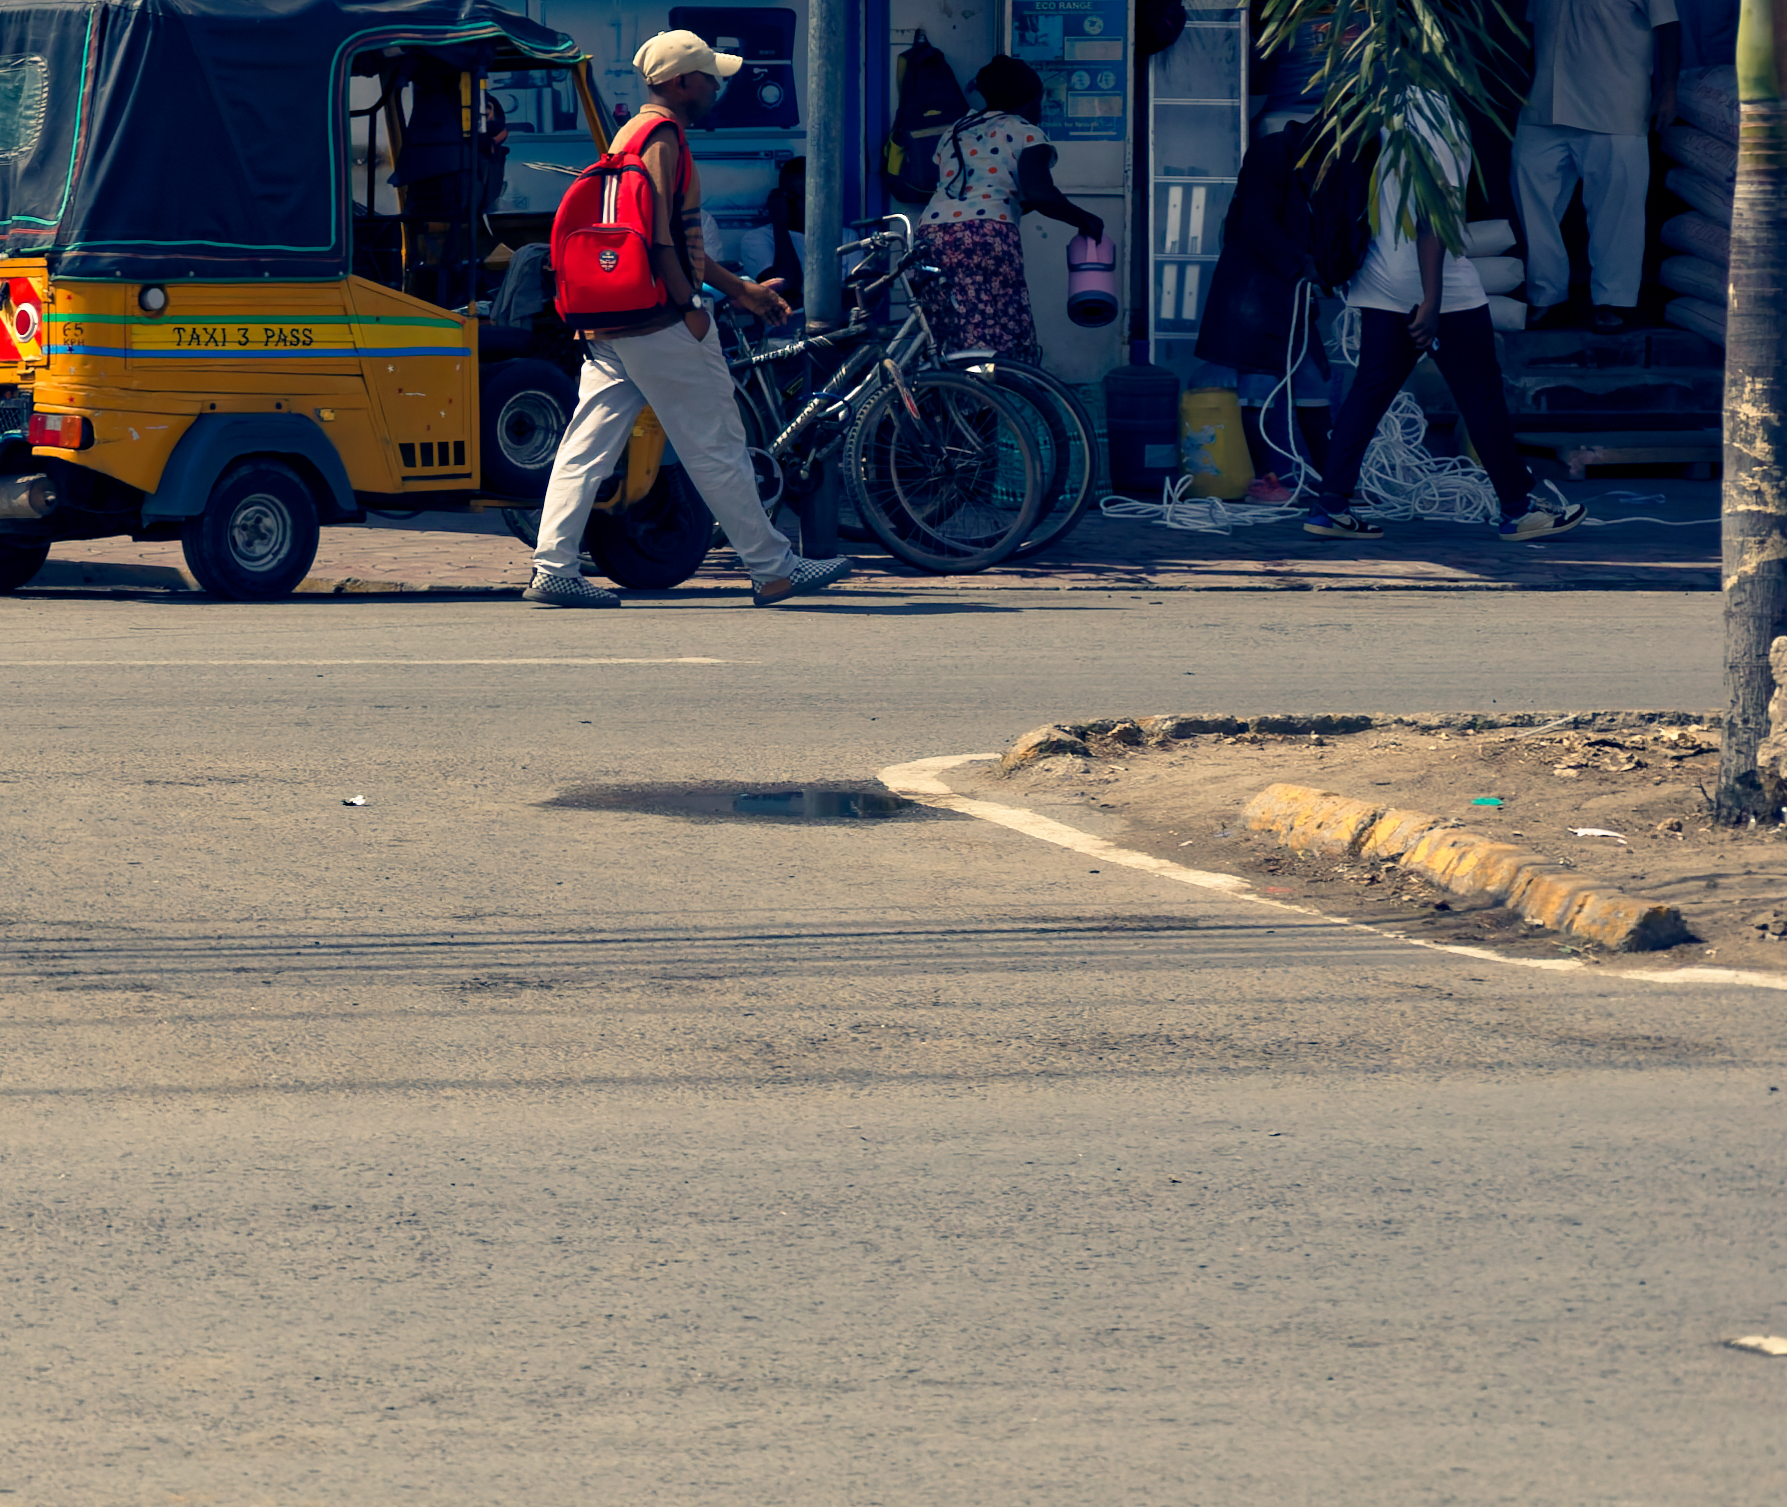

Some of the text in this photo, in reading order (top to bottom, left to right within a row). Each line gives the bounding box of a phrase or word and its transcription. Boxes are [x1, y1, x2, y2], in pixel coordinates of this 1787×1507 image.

[1036, 1, 1094, 10] ECO RANGE
[63, 322, 84, 338] 65
[63, 338, 85, 347] KPH
[172, 327, 315, 348] TAXI 3 PASS
